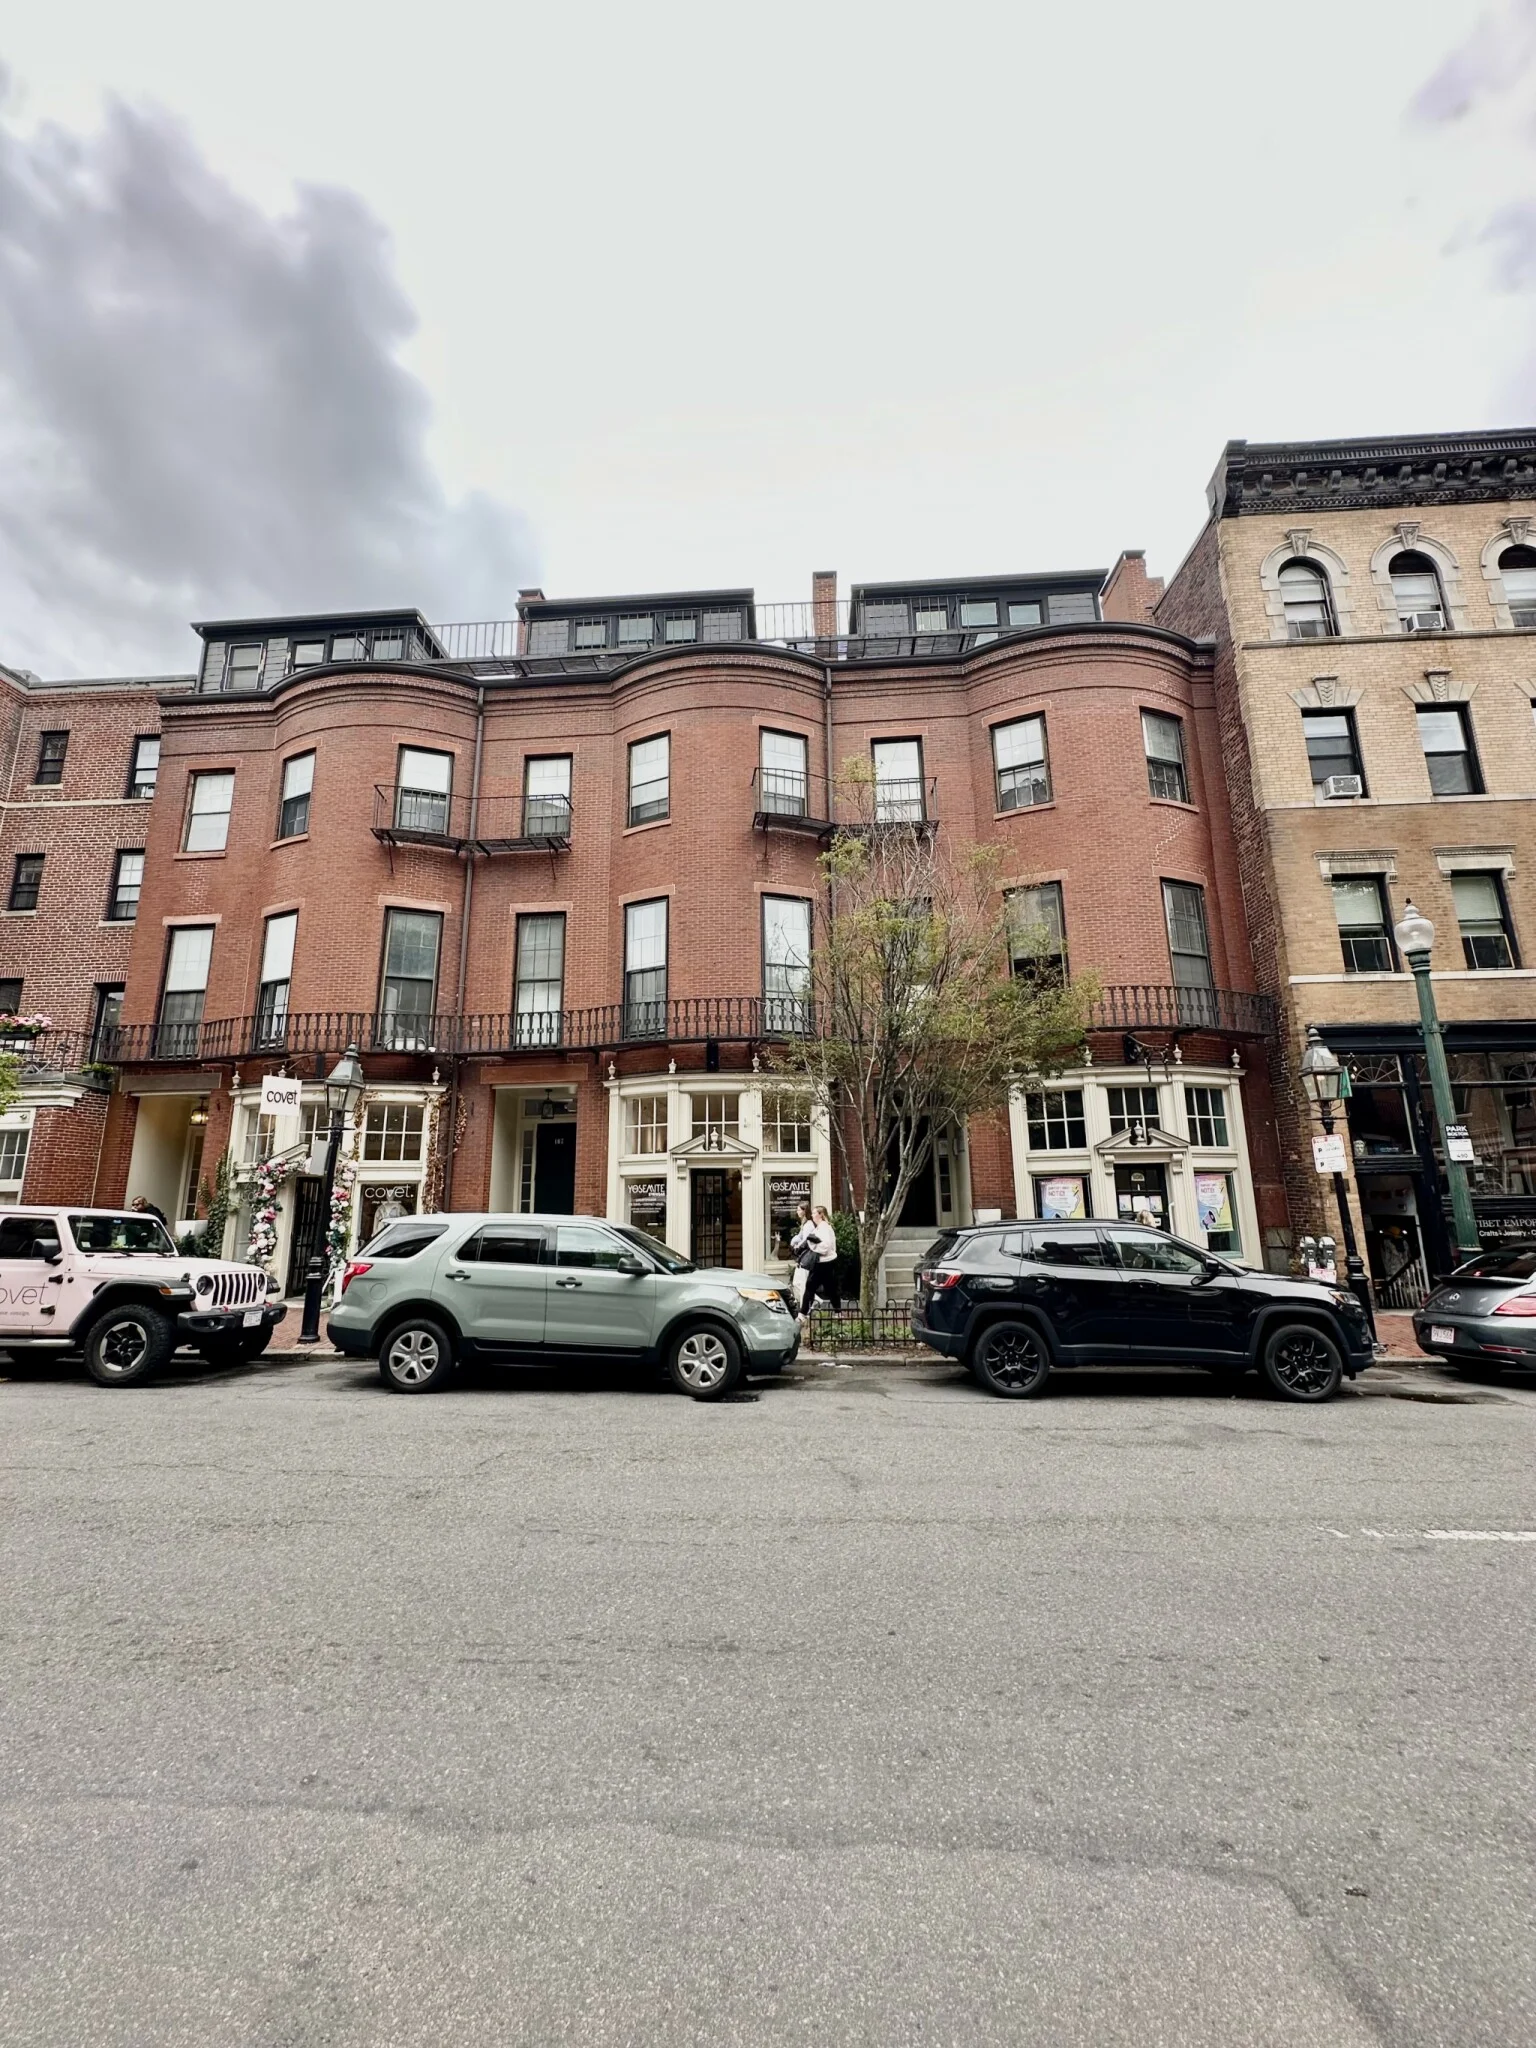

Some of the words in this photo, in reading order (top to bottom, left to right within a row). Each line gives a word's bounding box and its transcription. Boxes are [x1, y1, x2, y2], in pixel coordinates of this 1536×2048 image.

[266, 1090, 298, 1105] covet
[627, 1184, 666, 1193] YOSEMITE
[767, 1182, 810, 1192] YOSEMITE
